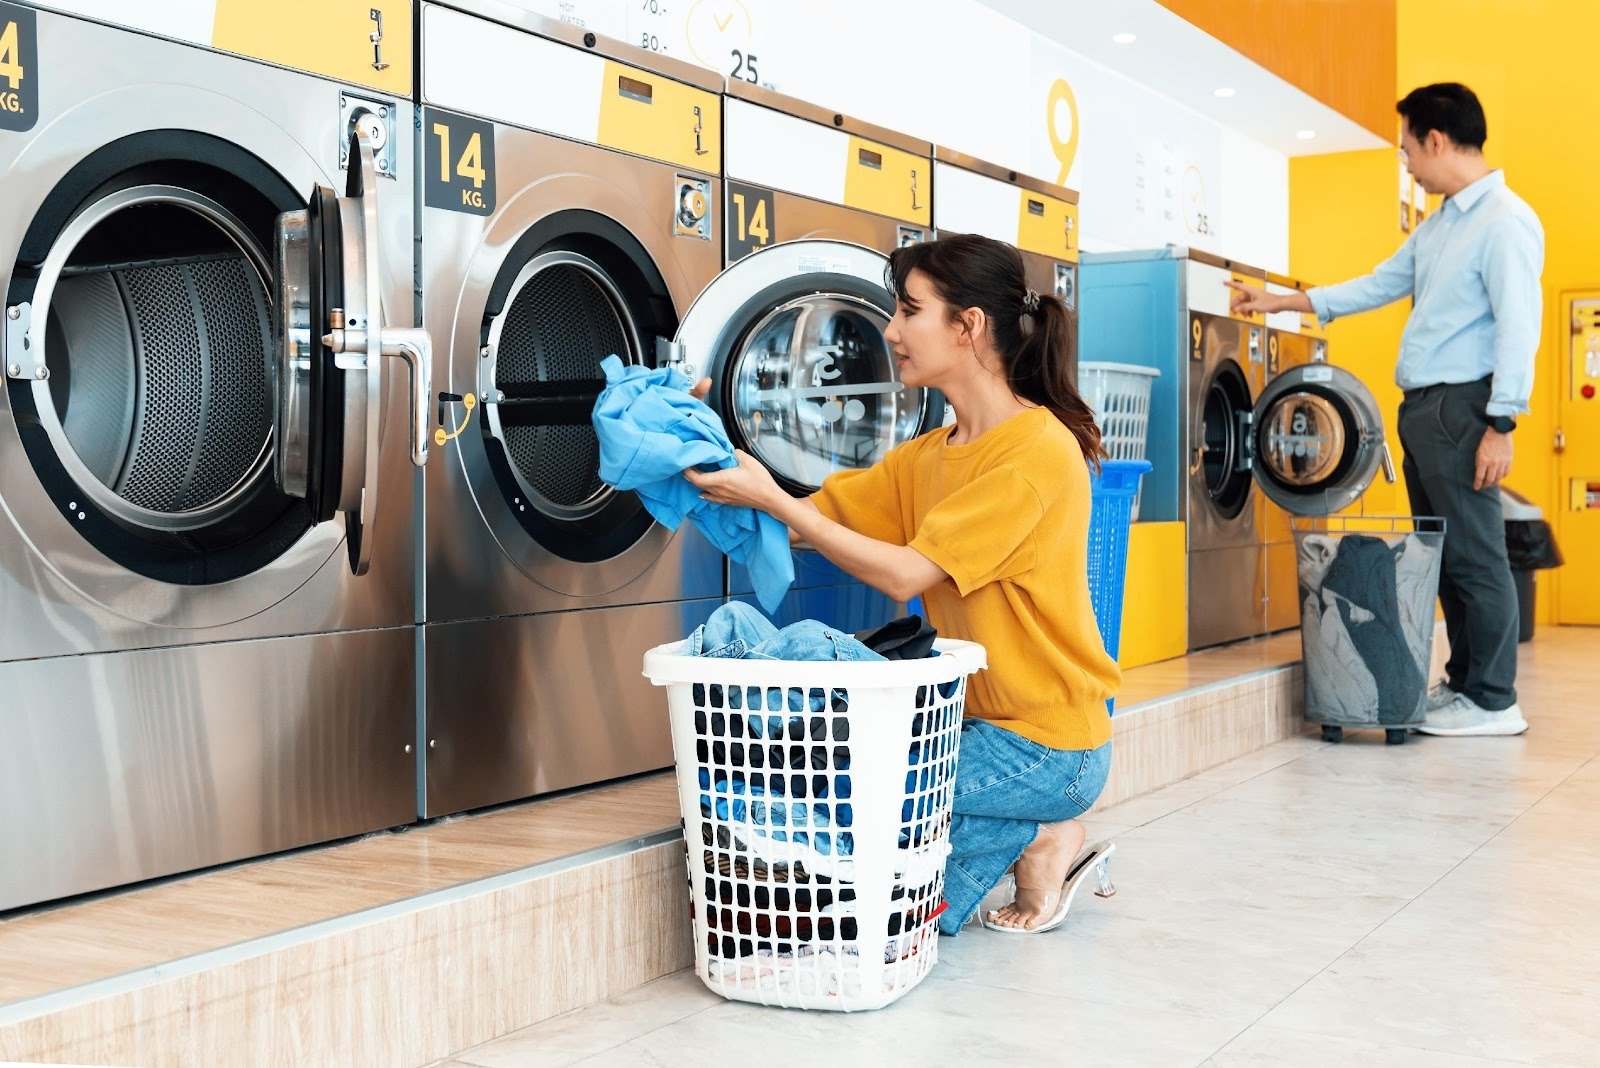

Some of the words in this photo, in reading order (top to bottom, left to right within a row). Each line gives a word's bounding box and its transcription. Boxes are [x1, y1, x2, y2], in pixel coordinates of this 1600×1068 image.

[731, 49, 758, 85] 25
[1046, 78, 1080, 187] 9
[433, 122, 486, 189] 14
[462, 189, 487, 209] KG.
[733, 193, 769, 245] 14
[1197, 213, 1208, 235] 25
[1192, 319, 1203, 349] 9
[1269, 335, 1278, 362] 9
